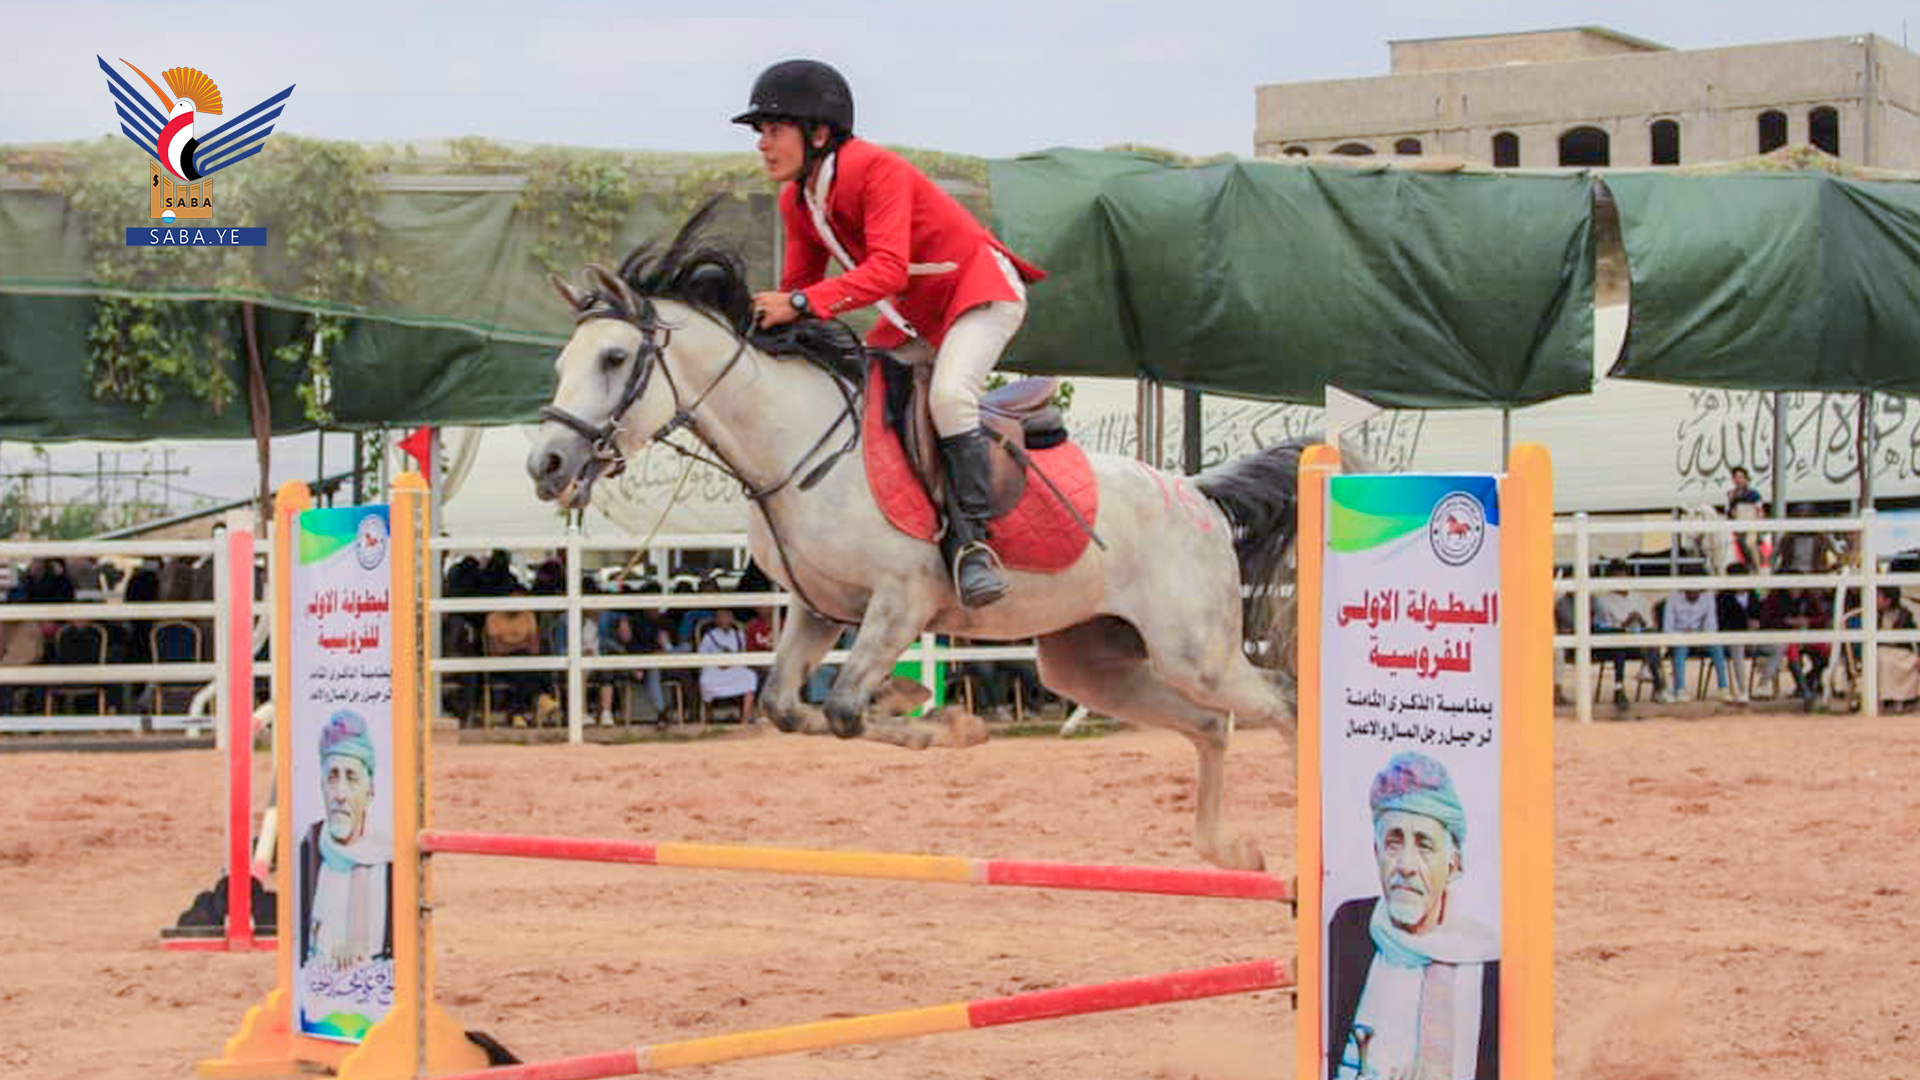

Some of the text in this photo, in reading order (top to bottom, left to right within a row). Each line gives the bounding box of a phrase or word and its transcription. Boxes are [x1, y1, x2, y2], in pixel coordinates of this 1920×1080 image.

[342, 587, 389, 619] لبطولة
[1406, 588, 1499, 632] البطولة
[1368, 634, 1473, 679] للفروسية
